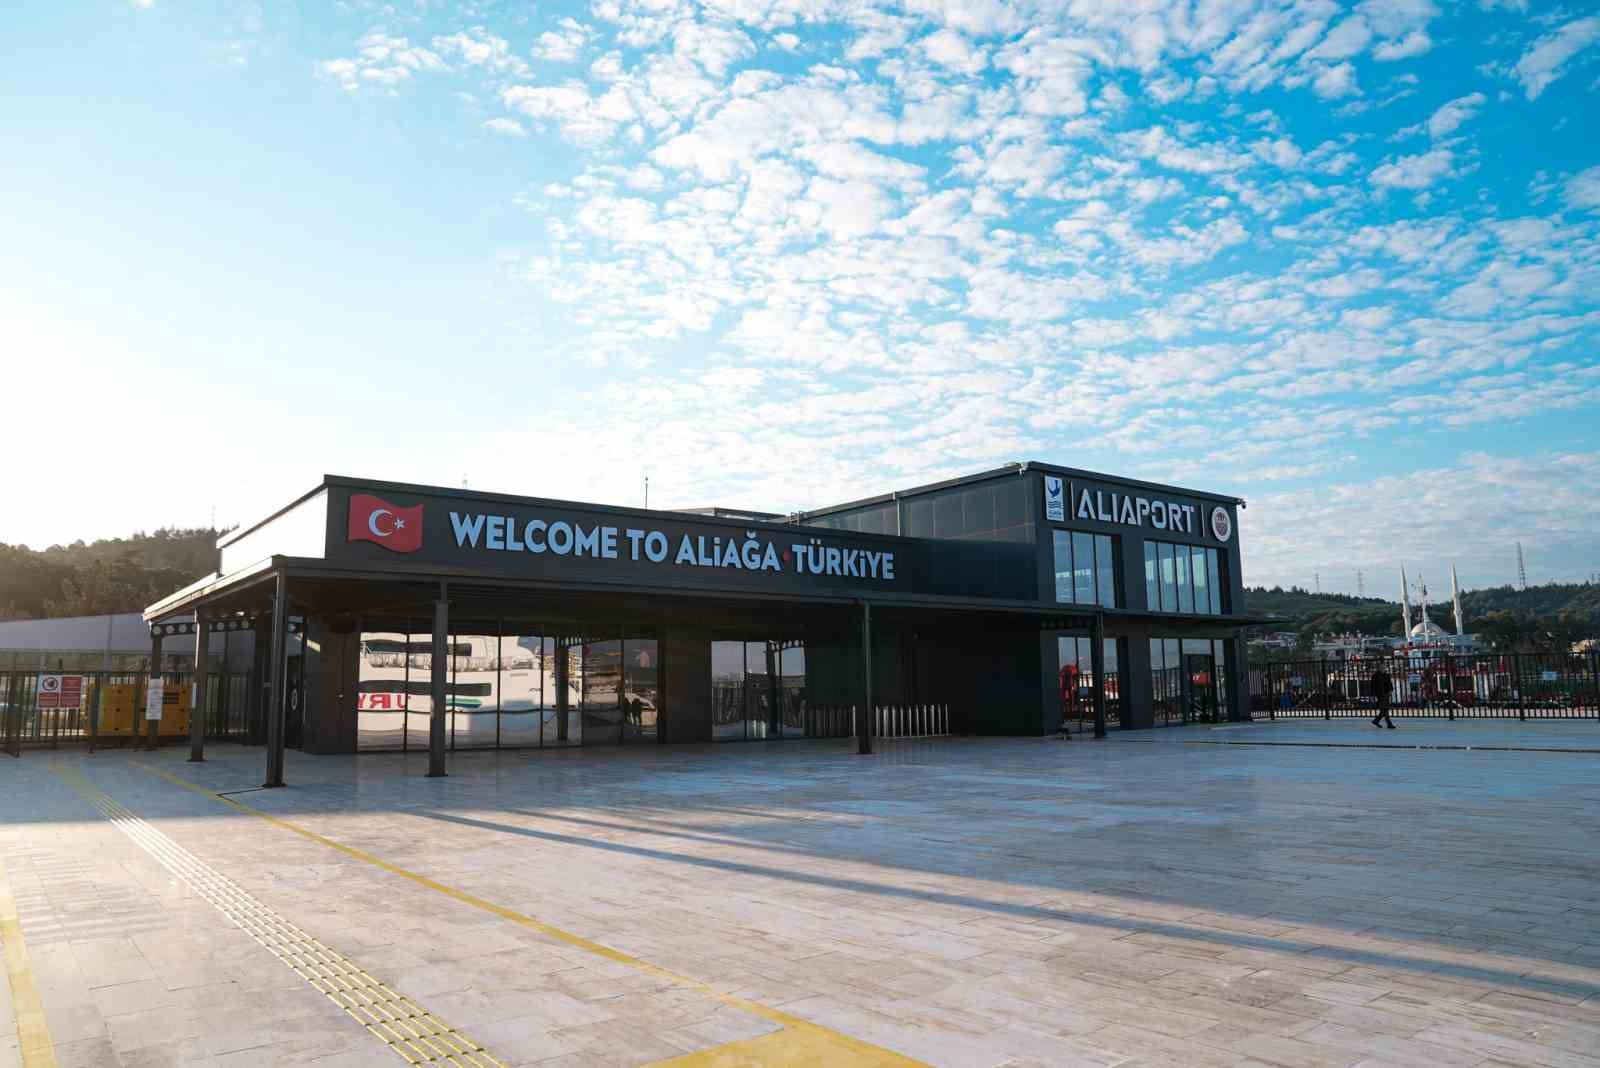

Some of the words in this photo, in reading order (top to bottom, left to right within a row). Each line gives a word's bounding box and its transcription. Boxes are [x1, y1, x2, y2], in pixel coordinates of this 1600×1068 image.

[1077, 488, 1195, 533] ALIAPORT
[449, 511, 618, 559] WELCOME
[626, 528, 668, 562] TO
